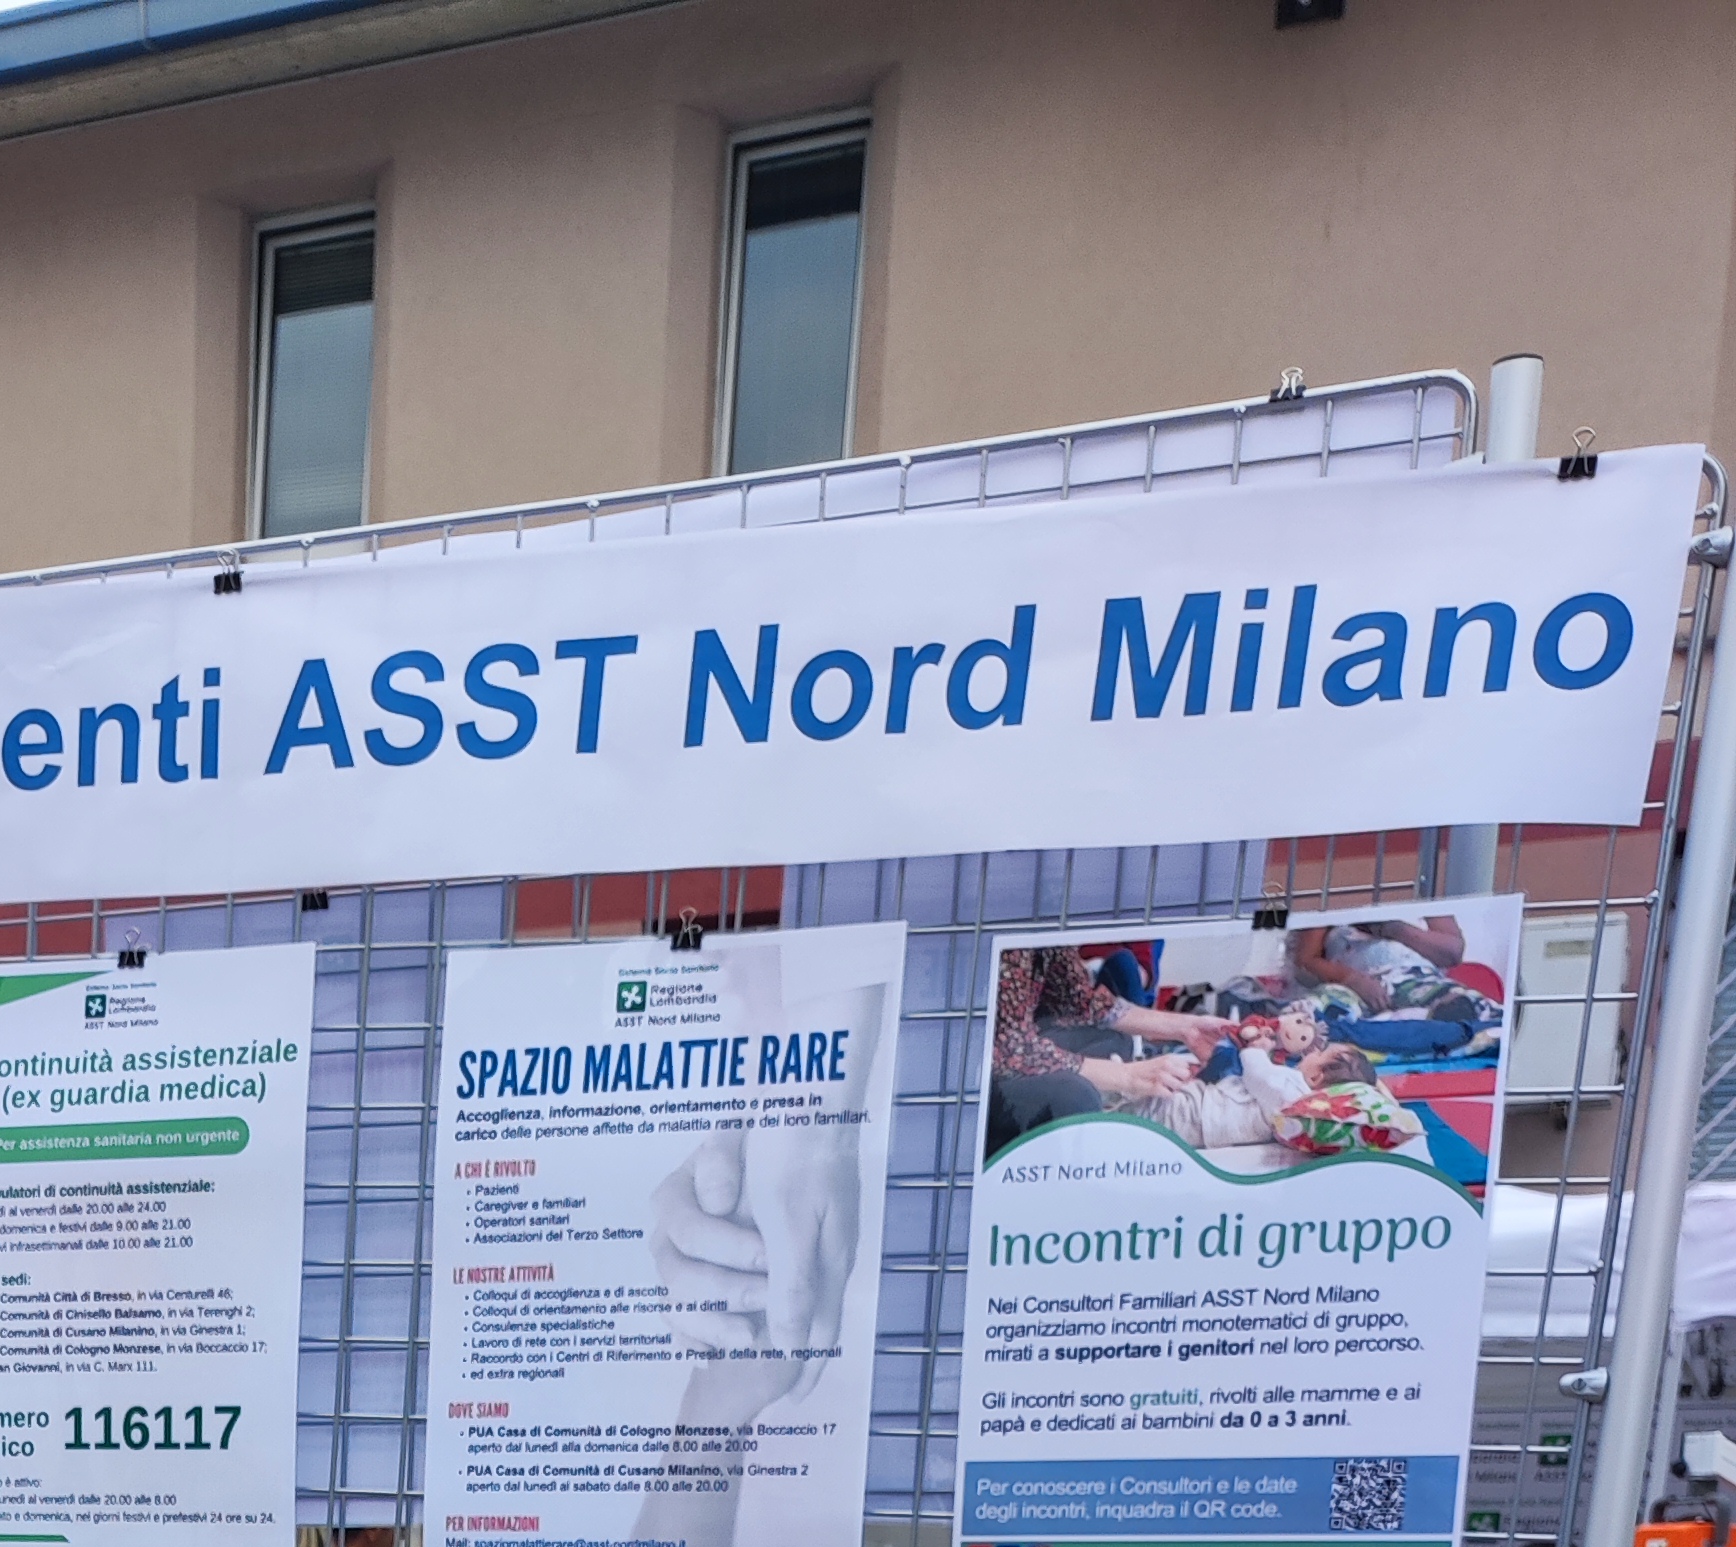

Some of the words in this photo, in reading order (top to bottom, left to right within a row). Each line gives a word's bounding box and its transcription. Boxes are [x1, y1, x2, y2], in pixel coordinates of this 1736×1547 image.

[263, 634, 638, 775] ASST
[683, 610, 1036, 748] Nord
[1090, 591, 1633, 721] Milano
[122, 1037, 297, 1071] assistenziale
[456, 1045, 572, 1099] SPAZIO
[582, 1035, 748, 1093] MALATTIE
[757, 1029, 849, 1084] RARE
[2, 1084, 40, 1115] (ex
[50, 1079, 150, 1112] guardia
[159, 1071, 265, 1103] medica)
[19, 1136, 90, 1150] assistenza
[93, 1132, 152, 1146] sanitaria
[155, 1132, 182, 1144] non
[185, 1129, 239, 1145] urgente
[1001, 1165, 1051, 1183] ASST
[1058, 1161, 1105, 1179] Nord
[1114, 1160, 1182, 1176] Milano
[43, 1184, 55, 1197] di
[59, 1182, 123, 1197] continuità
[126, 1179, 214, 1194] assistenziale:
[989, 1215, 1183, 1266] Incontri
[1198, 1212, 1243, 1257] di
[1257, 1215, 1451, 1268] gruppo
[1, 1273, 30, 1286] sedi:
[987, 1297, 1017, 1314] Nei
[1023, 1293, 1113, 1313] Consultori
[1118, 1291, 1196, 1310] Familiari
[1200, 1288, 1259, 1307] ASST
[1263, 1287, 1309, 1305] Nord
[1315, 1286, 1379, 1303] Milano
[985, 1318, 1106, 1341] organizziamo
[1111, 1315, 1176, 1334] incontri
[1182, 1312, 1307, 1332] monotematici
[1313, 1311, 1329, 1328] di
[1335, 1312, 1408, 1332] gruppo,
[984, 1343, 1032, 1361] mirati
[1037, 1347, 1049, 1360] a
[1054, 1342, 1161, 1362] supportare
[1167, 1340, 1172, 1357] i
[1177, 1338, 1254, 1360] genitori
[1259, 1337, 1288, 1354] nel
[1293, 1337, 1329, 1353] loro
[1334, 1337, 1423, 1355] percorso.
[982, 1391, 1005, 1409] Gli
[1010, 1390, 1074, 1408] incontri
[1079, 1393, 1124, 1407] sono
[1129, 1388, 1203, 1407] gratuiti,
[1209, 1386, 1257, 1404] rivolti
[1262, 1386, 1294, 1403] alle
[1300, 1387, 1380, 1402] mamme
[1385, 1387, 1397, 1400] e
[1403, 1383, 1421, 1400] ai
[64, 1405, 241, 1450] 116117
[980, 1415, 1024, 1436] papà
[1030, 1419, 1041, 1431] e
[1046, 1413, 1115, 1431] dedicati
[1120, 1413, 1136, 1430] ai
[1141, 1411, 1213, 1429] bambini
[1219, 1411, 1244, 1428] da
[1249, 1410, 1262, 1427] 0
[1267, 1414, 1278, 1427] a
[1285, 1409, 1296, 1427] 3
[1302, 1408, 1350, 1426] anni.
[976, 1478, 1009, 1496] Per
[1011, 1480, 1106, 1495] conoscere
[1109, 1480, 1115, 1494] i
[1119, 1476, 1213, 1495] Consultori
[1216, 1479, 1229, 1494] e
[1233, 1476, 1251, 1493] le
[1254, 1476, 1298, 1493] date
[975, 1501, 1018, 1523] degli
[1021, 1501, 1090, 1519] incontri,
[1095, 1500, 1175, 1521] inquadra
[1180, 1500, 1189, 1517] il
[1193, 1500, 1226, 1518] QR
[1230, 1499, 1281, 1517] code.
